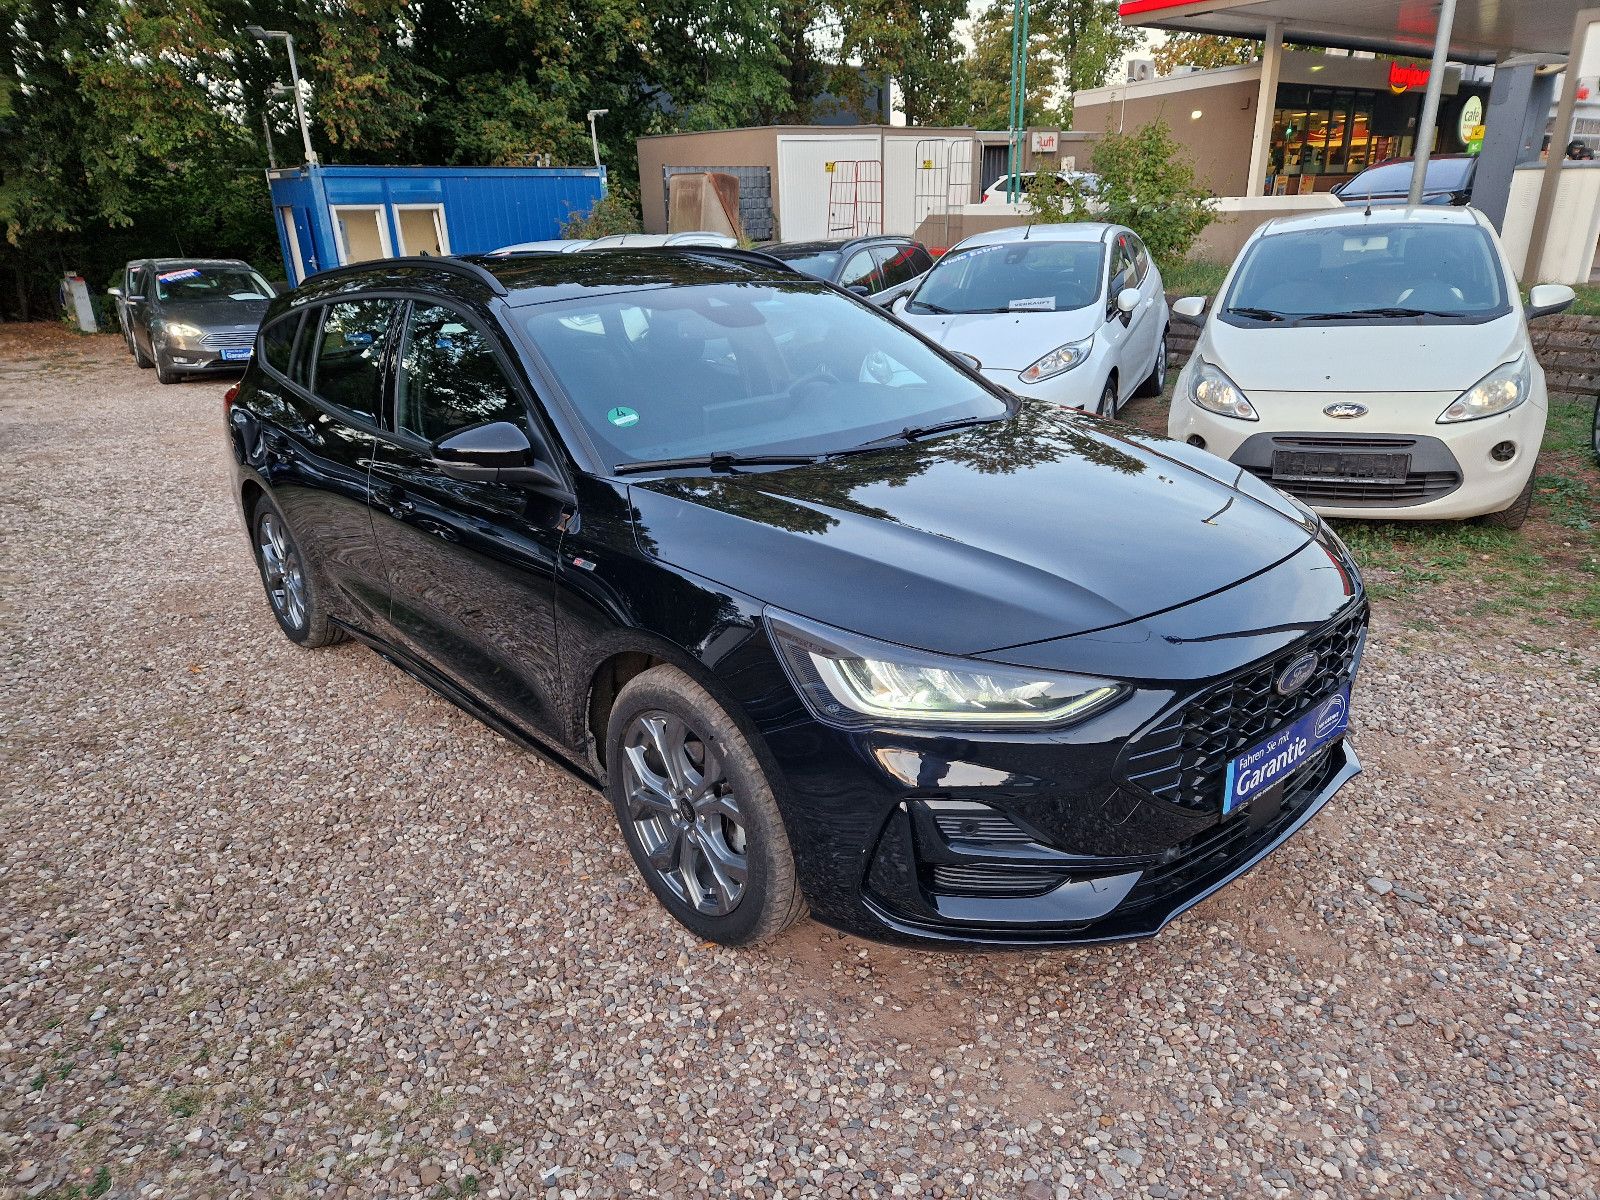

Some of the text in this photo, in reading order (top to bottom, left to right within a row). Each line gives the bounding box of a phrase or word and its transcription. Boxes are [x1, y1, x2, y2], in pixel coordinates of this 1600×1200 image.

[1040, 135, 1054, 147] Luft
[616, 407, 626, 417] 4
[1239, 730, 1290, 771] Fahren Sie mit
[1236, 736, 1307, 796] Garantie
